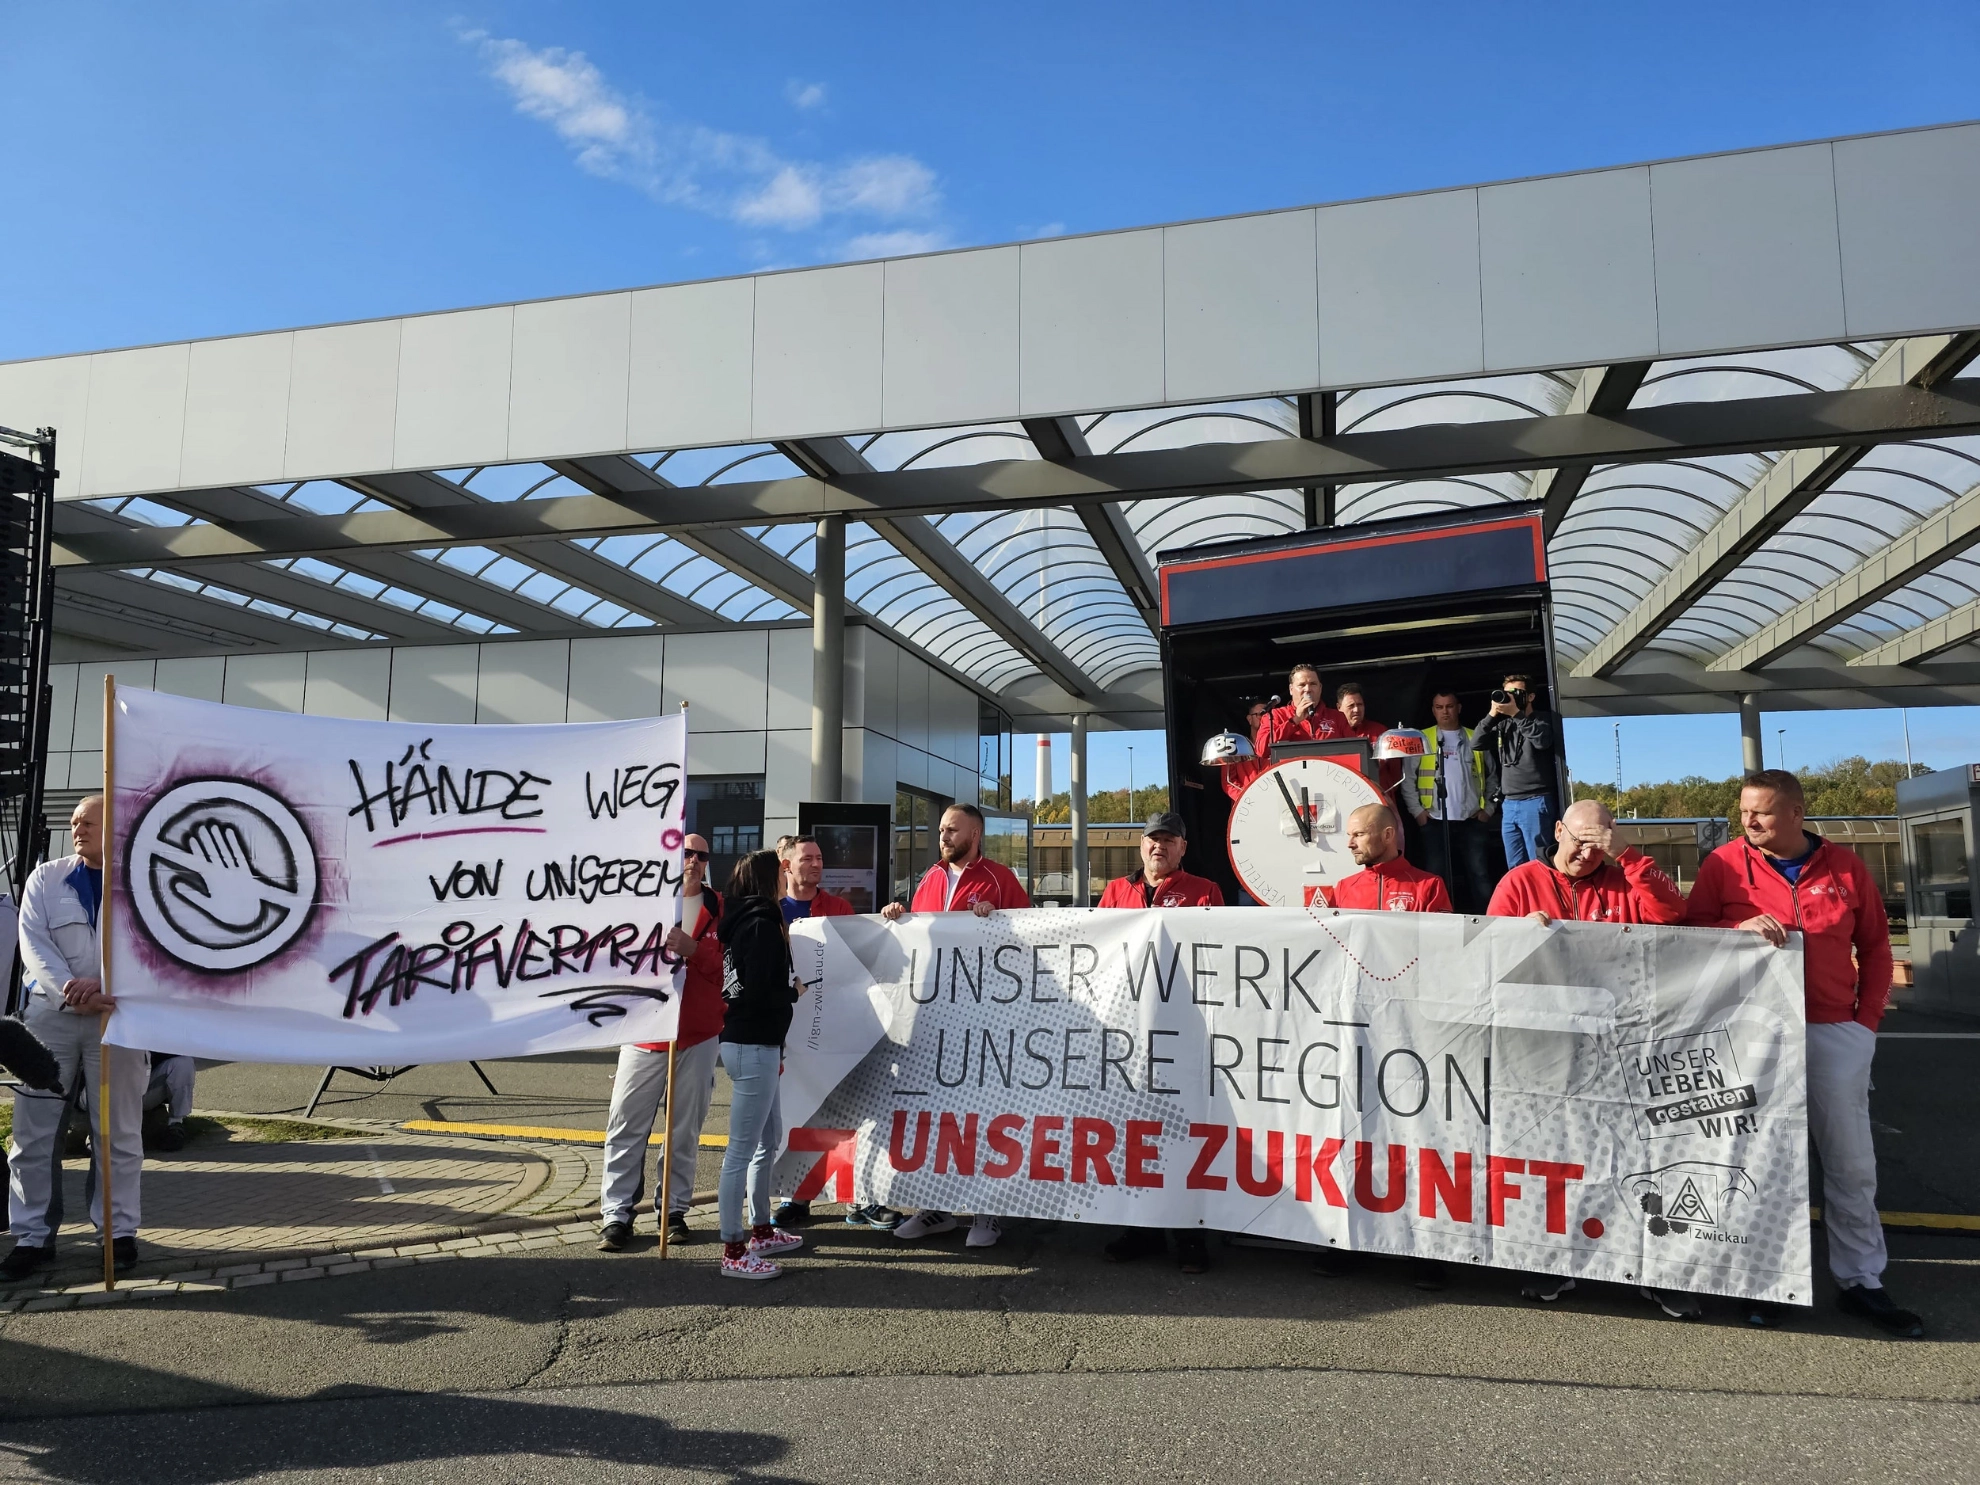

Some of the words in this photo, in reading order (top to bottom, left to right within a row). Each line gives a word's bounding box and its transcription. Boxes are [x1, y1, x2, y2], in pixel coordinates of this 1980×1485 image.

[1213, 735, 1237, 755] 35
[348, 738, 552, 831] HÄNDE
[586, 763, 687, 851] WEG
[1326, 765, 1378, 806] VERDIE
[429, 858, 503, 901] VON
[526, 855, 685, 904] UNSEREM
[1237, 858, 1287, 907] VERTEILT
[909, 943, 1100, 1004] UNSER
[1209, 1034, 1490, 1125] REGION
[1635, 1047, 1718, 1076] UNSER
[1646, 1069, 1726, 1098] LEBEN
[1655, 1087, 1749, 1124] gestalten
[1697, 1113, 1759, 1139] WIR!
[888, 1109, 1165, 1189] UNSERE
[1186, 1122, 1606, 1240] ZUKUNFT.
[1694, 1228, 1748, 1245] Zwickau
